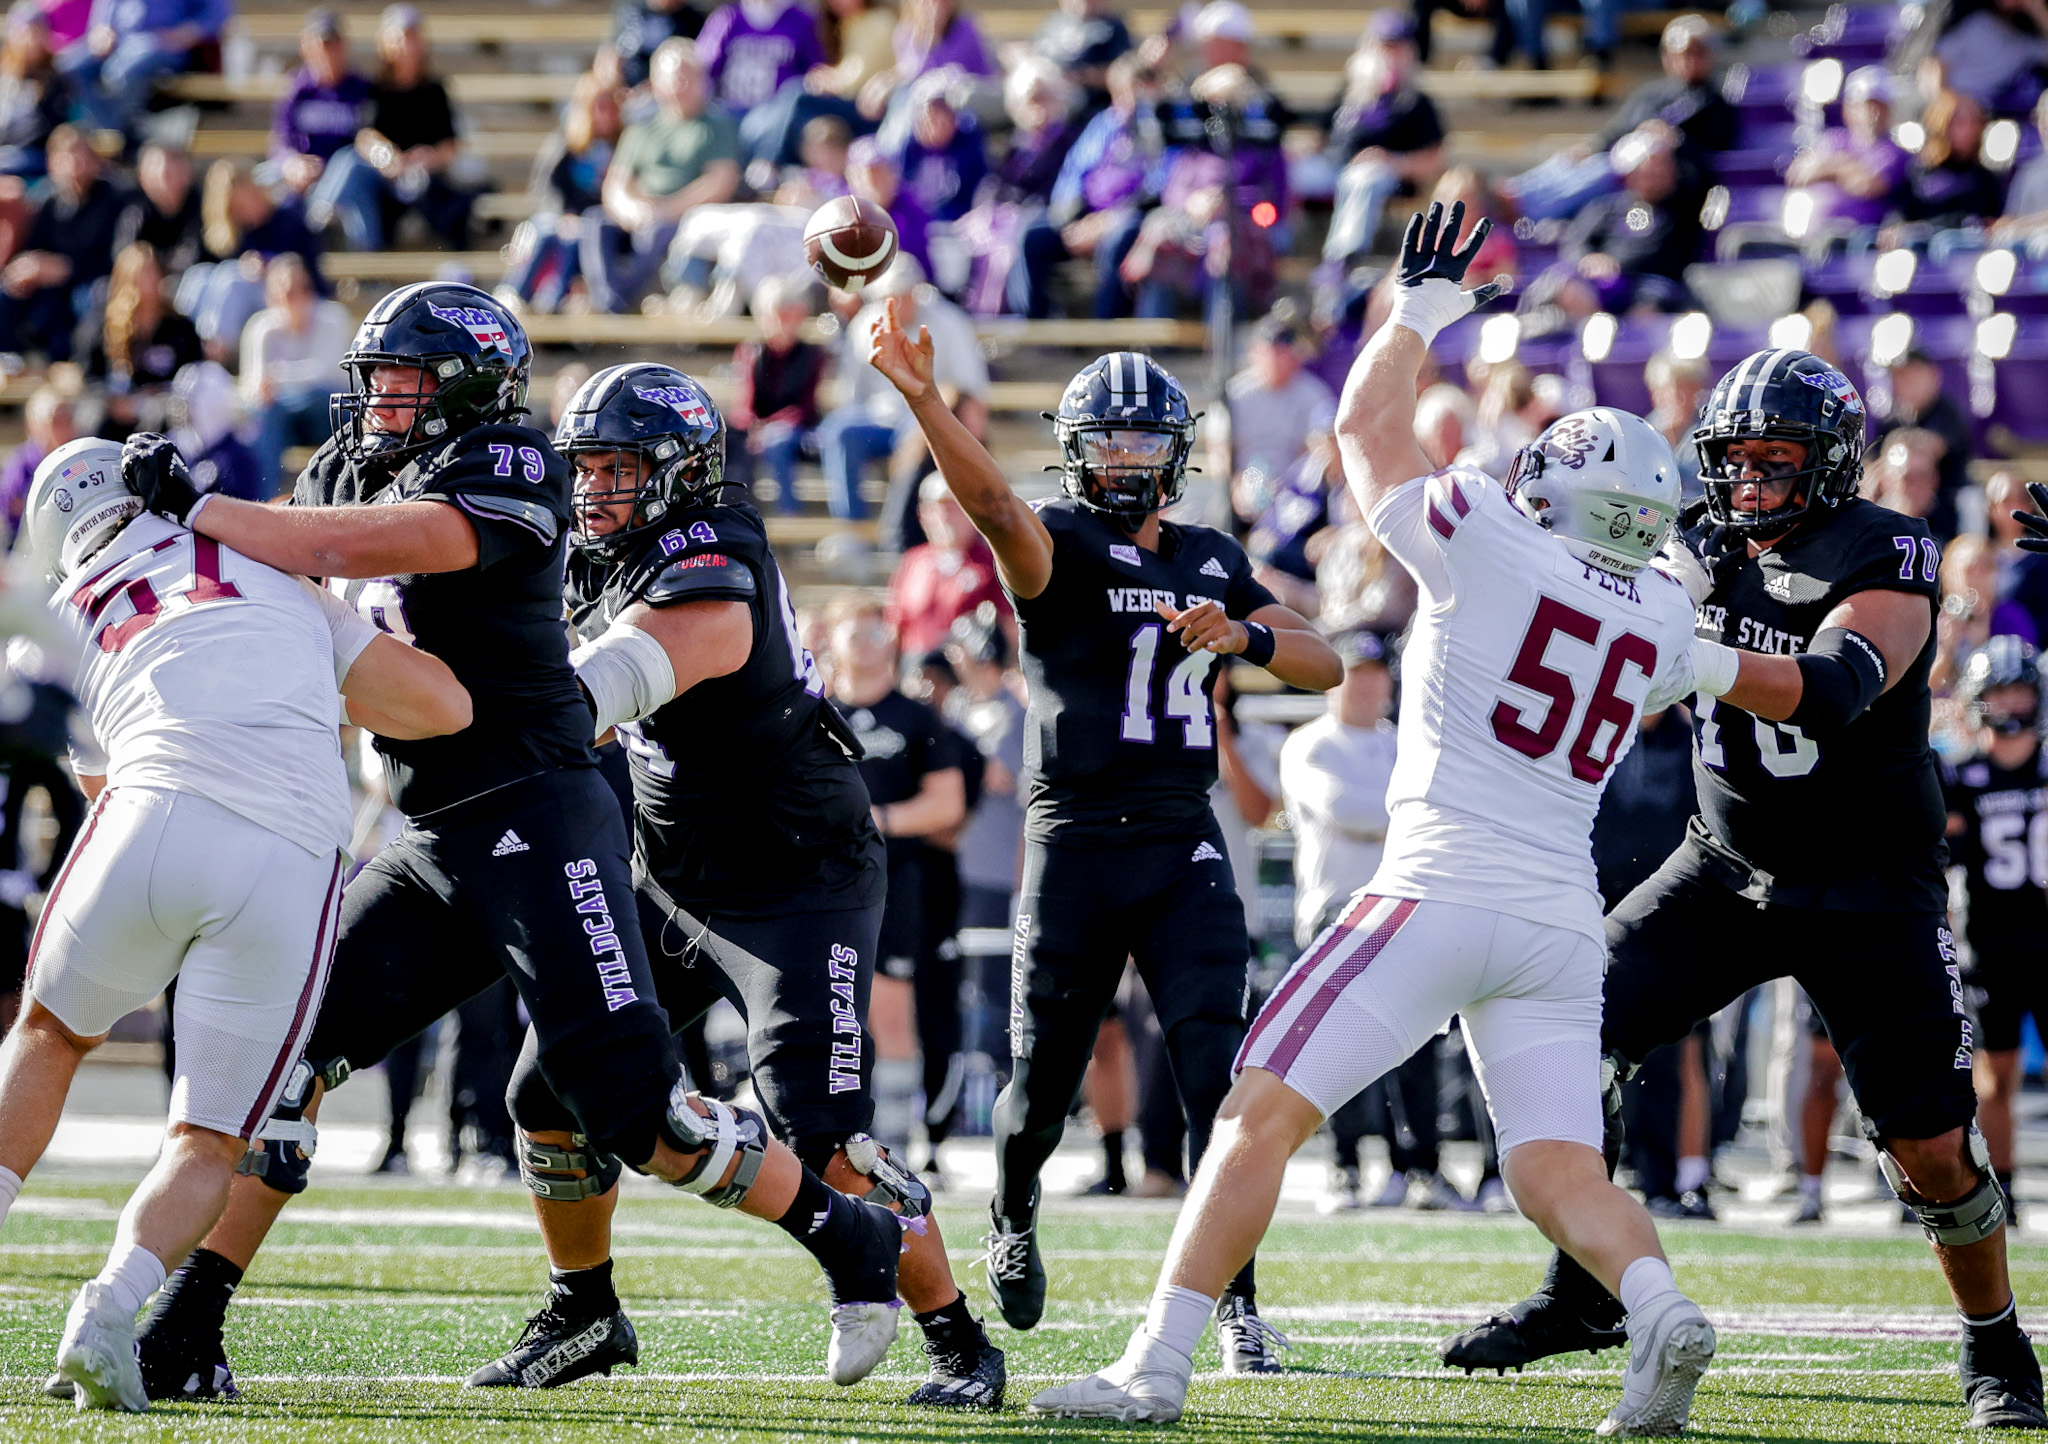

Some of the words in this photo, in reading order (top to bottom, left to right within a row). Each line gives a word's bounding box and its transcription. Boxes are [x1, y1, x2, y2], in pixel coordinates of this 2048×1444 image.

[89, 470, 106, 487] 57
[488, 443, 545, 484] 79
[70, 531, 81, 545] UP
[78, 514, 100, 536] WITH
[98, 498, 141, 522] MONTANA
[658, 520, 719, 557] 64
[1642, 532, 1657, 548] 56
[1588, 550, 1601, 560] UP
[1600, 555, 1622, 570] WITH
[1892, 536, 1940, 582] 70
[1107, 588, 1178, 613] WEBER
[1694, 604, 1728, 633] BER
[1737, 616, 1804, 655] STATE
[1120, 622, 1214, 750] 14
[1486, 589, 1659, 789] 56
[492, 843, 530, 857] adidas
[564, 858, 639, 1012] WILDCATS
[1010, 913, 1032, 1058] WILDCATS
[829, 943, 862, 1094] WILDCATS
[520, 1317, 612, 1388] ADIZERO
